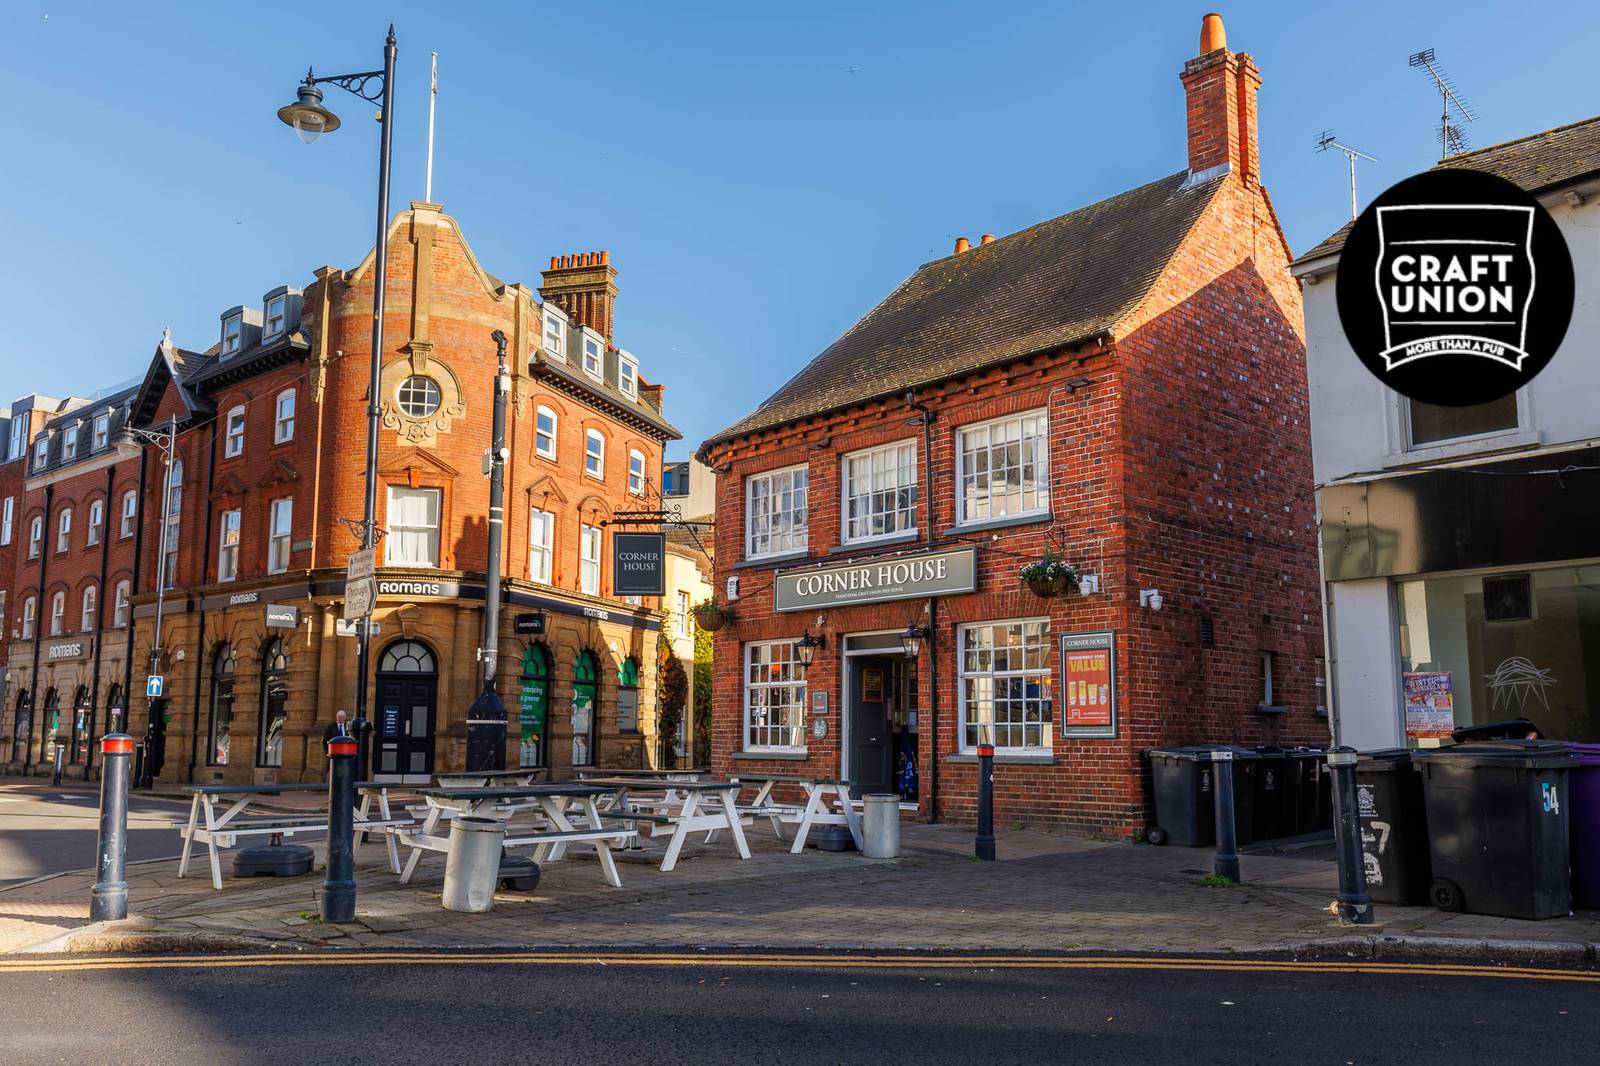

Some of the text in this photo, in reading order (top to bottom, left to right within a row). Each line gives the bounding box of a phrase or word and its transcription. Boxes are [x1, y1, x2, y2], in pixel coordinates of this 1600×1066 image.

[618, 552, 660, 561] CORNER
[623, 562, 657, 571] HOUSE
[796, 558, 948, 596] CORNER HOUSE
[1067, 639, 1089, 647] CORNER
[1070, 658, 1105, 672] VALUE
[1542, 783, 1559, 815] 54
